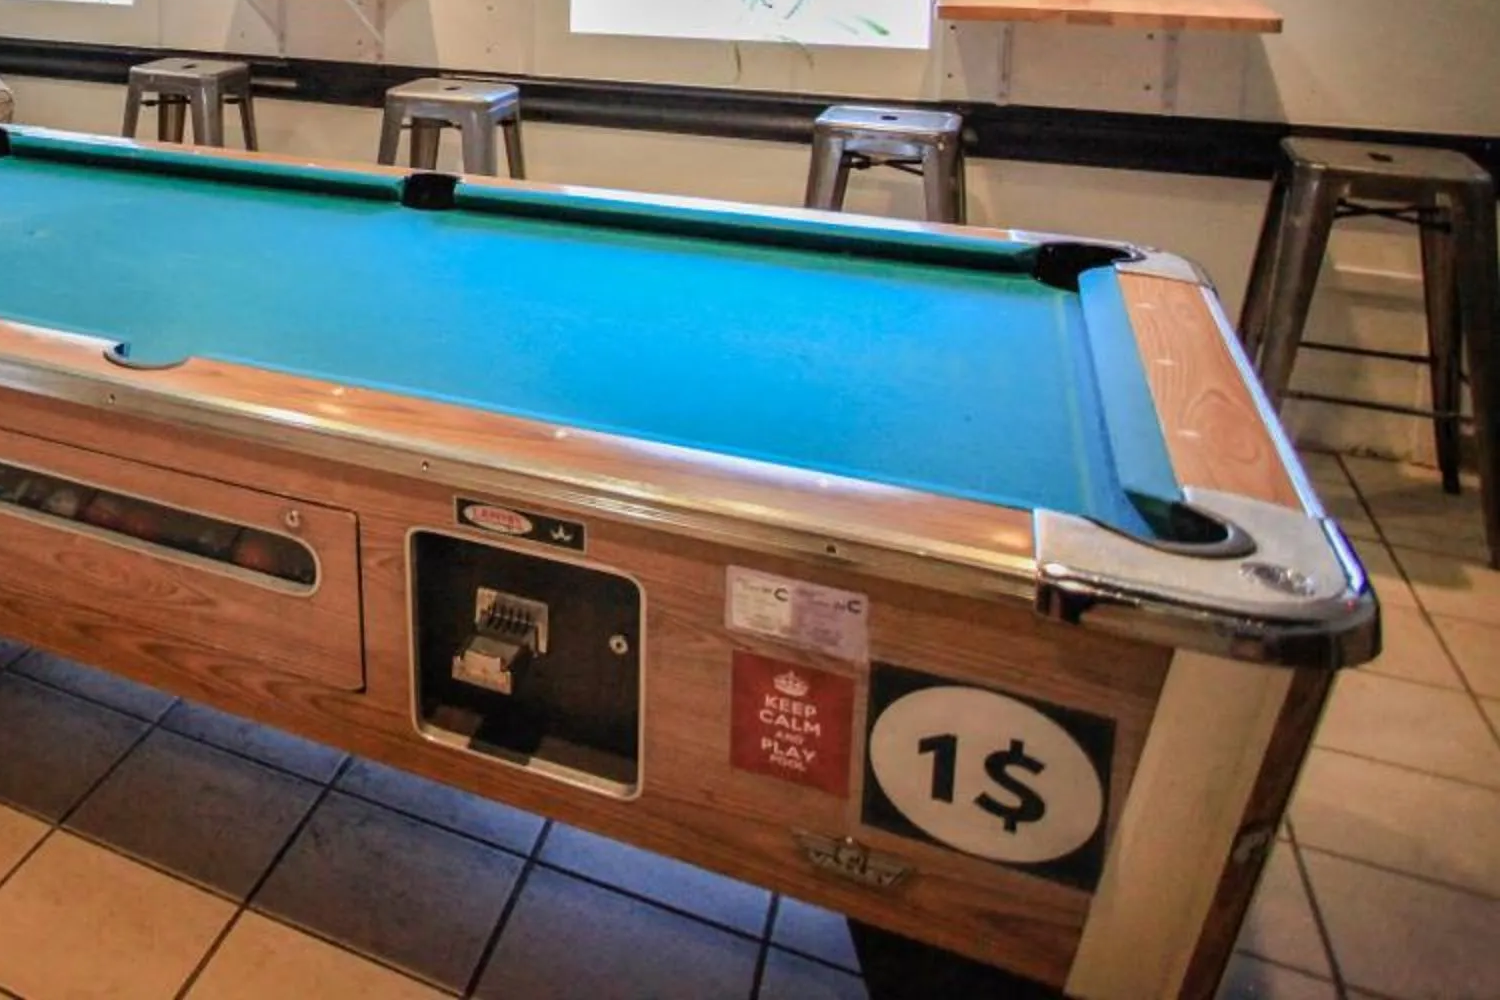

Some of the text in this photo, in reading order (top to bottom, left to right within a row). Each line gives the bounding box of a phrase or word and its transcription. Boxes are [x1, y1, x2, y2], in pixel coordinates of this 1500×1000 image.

[764, 693, 817, 718] KEEP
[759, 709, 821, 738] CALM
[761, 737, 817, 762] PLAY
[917, 733, 1046, 834] 1$
